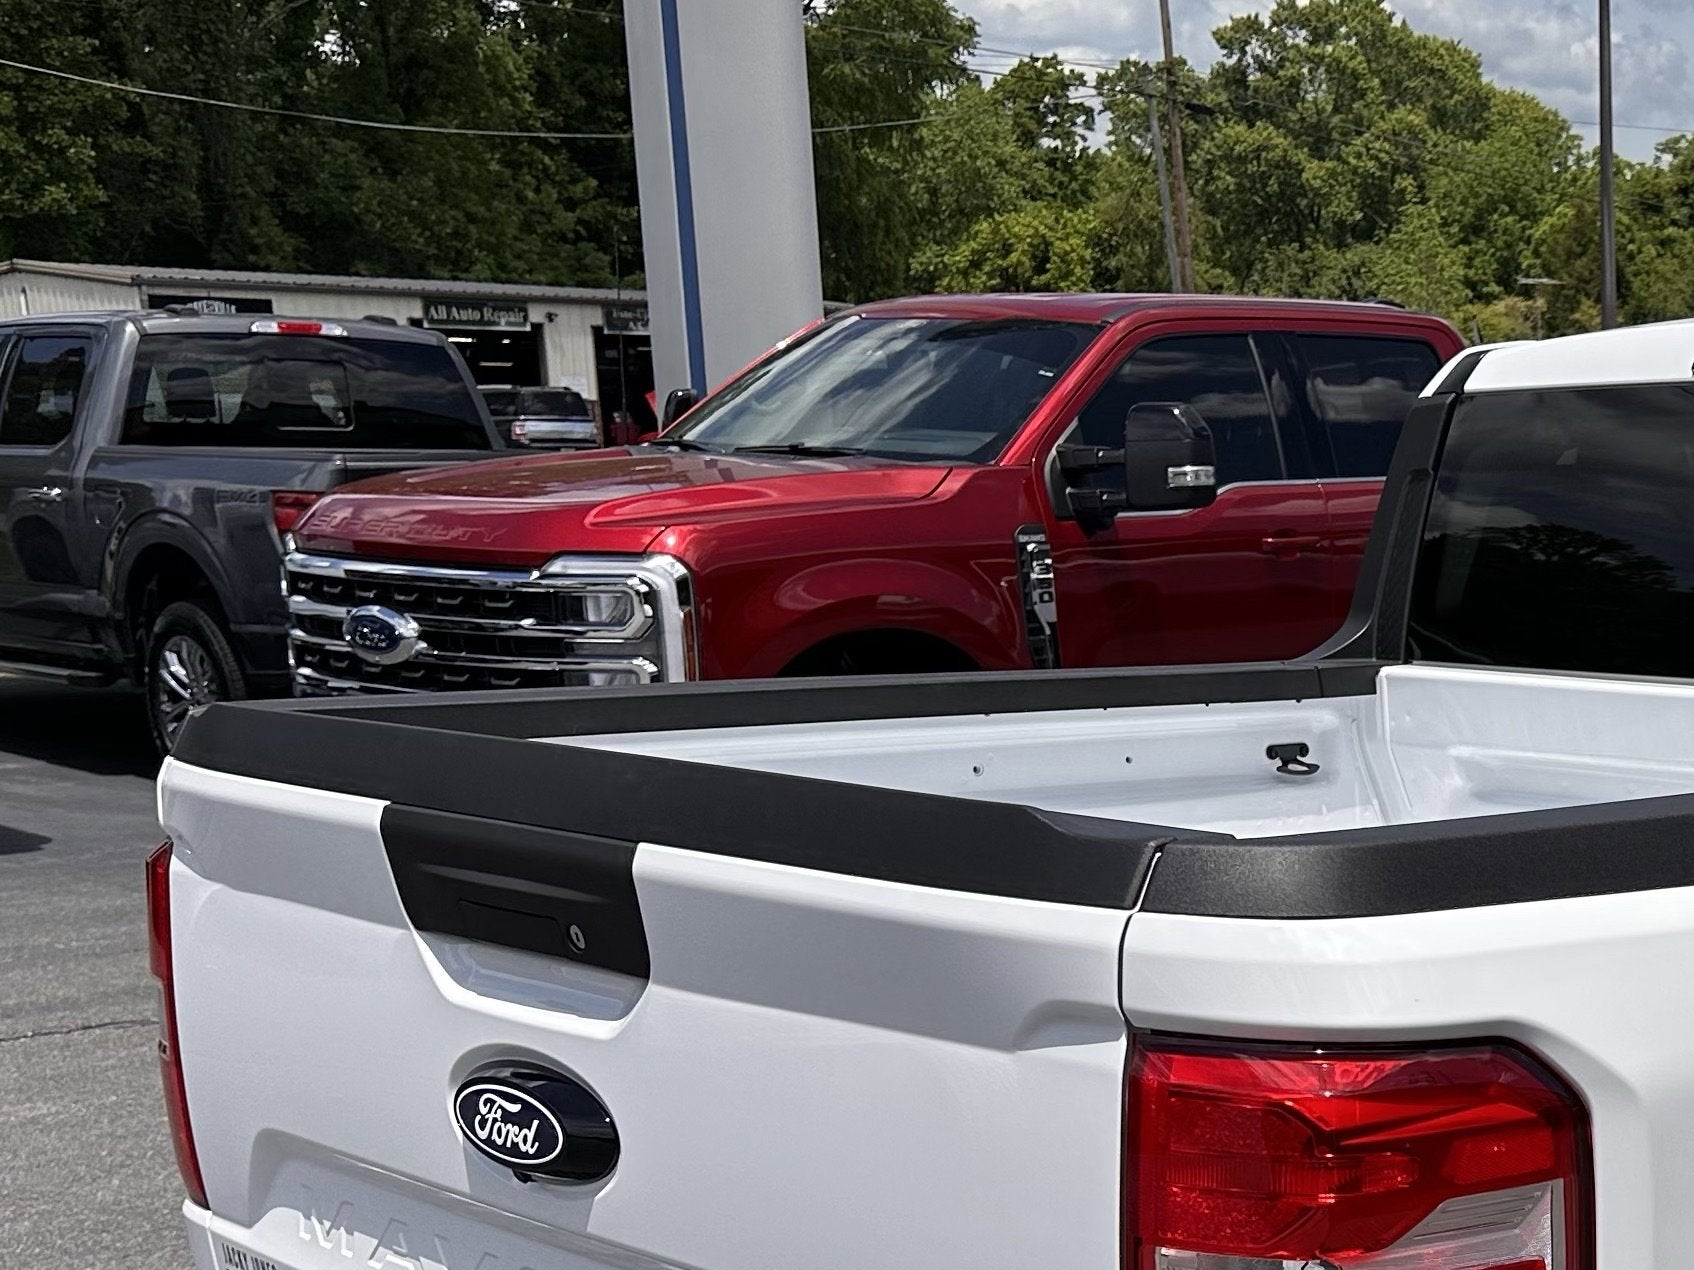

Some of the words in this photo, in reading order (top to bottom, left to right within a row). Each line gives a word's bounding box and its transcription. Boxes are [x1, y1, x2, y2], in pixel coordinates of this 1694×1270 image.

[428, 304, 447, 320] All
[450, 306, 480, 321] Auto
[483, 308, 526, 326] Repair
[311, 514, 405, 538] SUPER
[407, 520, 508, 543] DUTY
[474, 1092, 540, 1155] Ford
